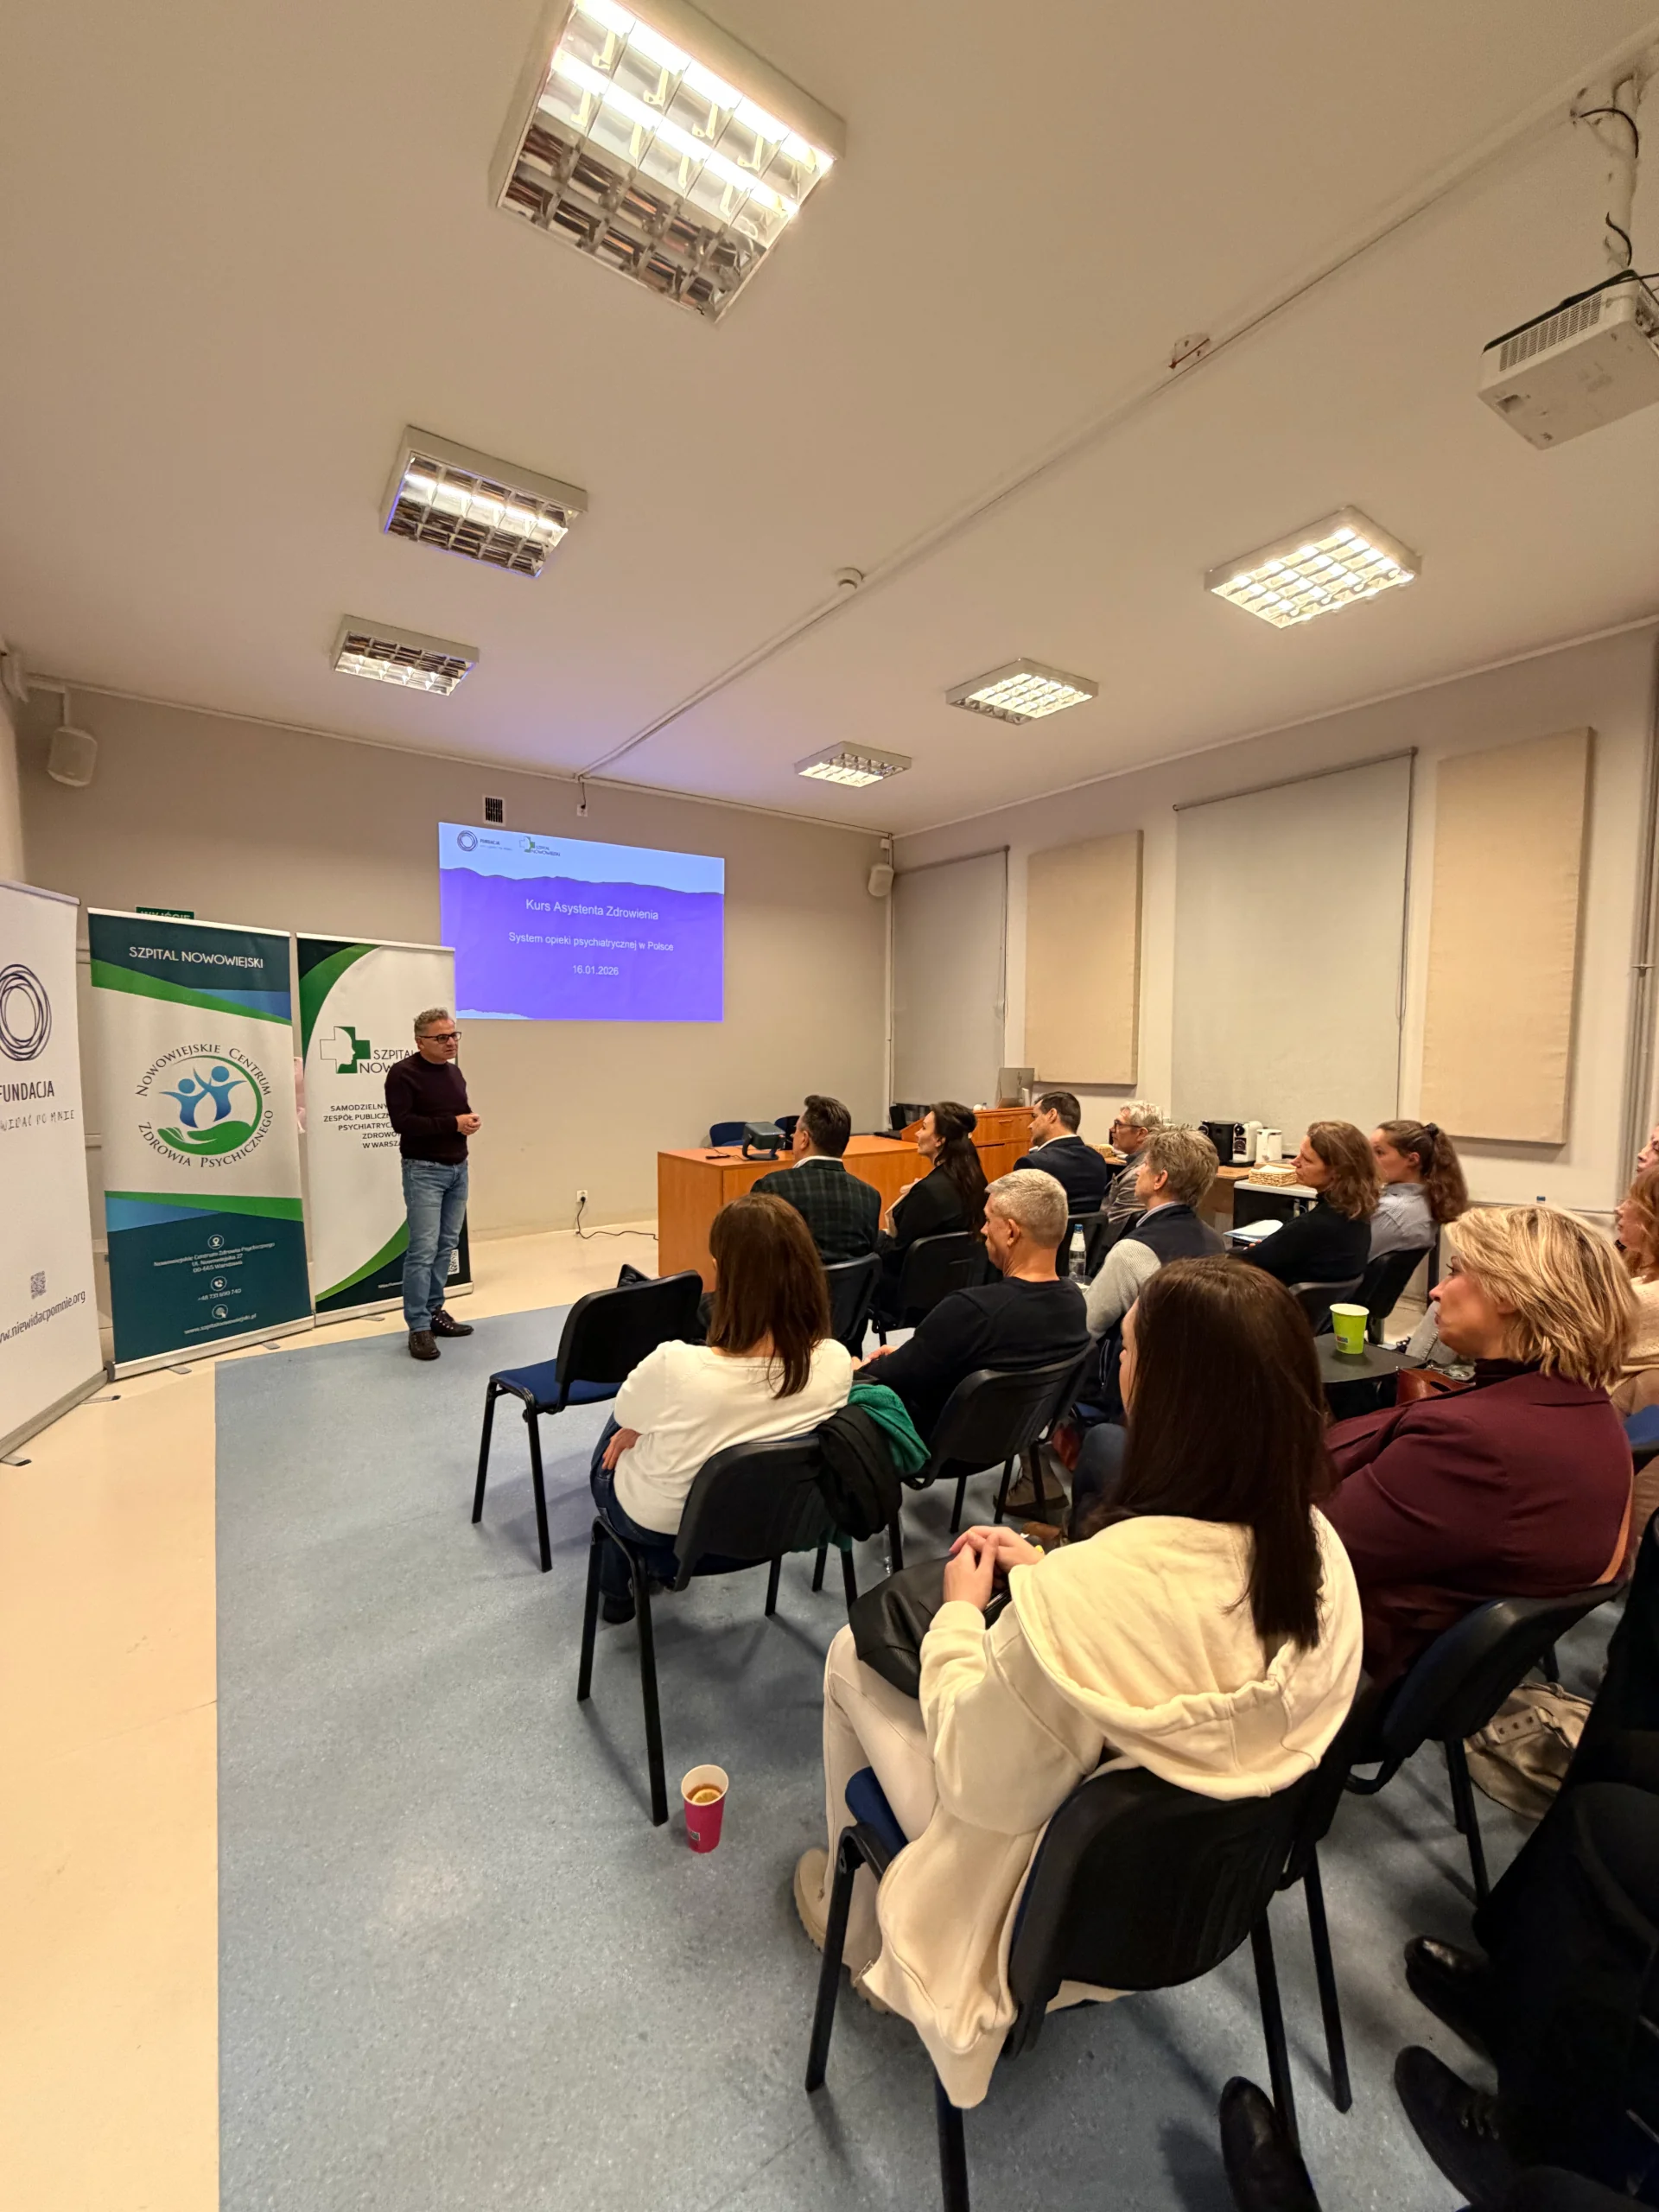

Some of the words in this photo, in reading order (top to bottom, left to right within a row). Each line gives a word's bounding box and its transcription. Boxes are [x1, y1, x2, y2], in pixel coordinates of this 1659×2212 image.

[525, 899, 550, 912] Kurs
[553, 901, 603, 916] Asystenta
[606, 906, 658, 920] Zdrowienia
[509, 931, 543, 944] System
[545, 935, 571, 945] opieki
[574, 938, 637, 950] psychiatrycznej
[647, 942, 674, 951] Polsce
[130, 947, 179, 961] SZPITAL
[181, 951, 264, 969] NOWOWIEJSKI
[573, 964, 620, 976] 16.01.2026
[330, 1103, 388, 1112] SAMODZIELNY
[323, 1114, 353, 1122] ZESPÓŁ
